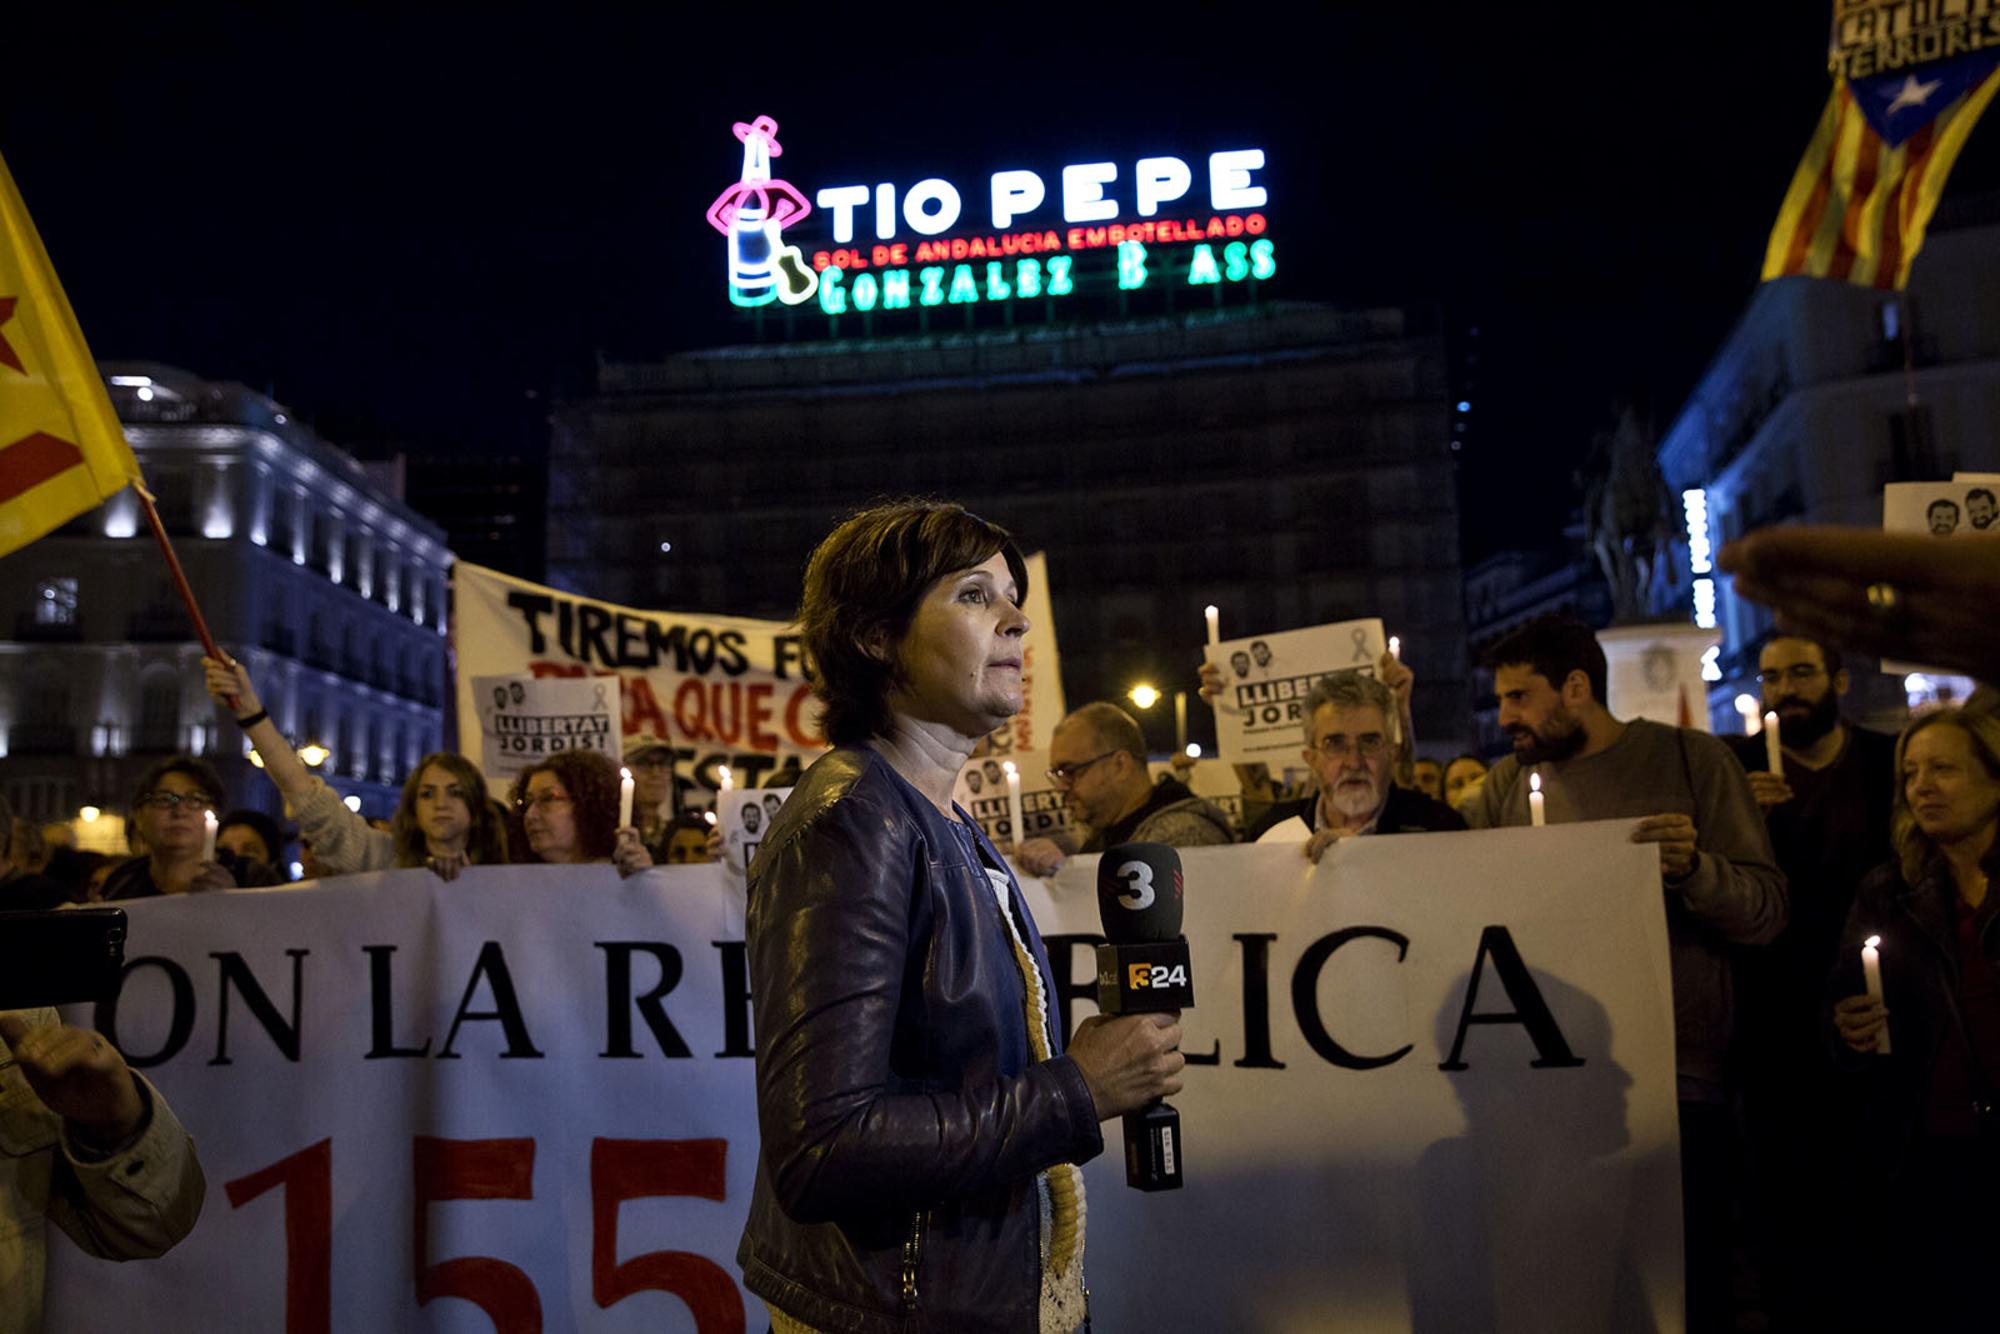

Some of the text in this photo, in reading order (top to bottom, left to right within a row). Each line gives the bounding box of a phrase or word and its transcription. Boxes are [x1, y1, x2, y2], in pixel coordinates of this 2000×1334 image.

[817, 148, 1268, 243] TIO PEPE
[813, 212, 1267, 273] SOL DE ANDALUCIA EMBOTELLADO
[818, 254, 1074, 315] GONZALEZ
[508, 591, 749, 677] TIREMOS
[496, 714, 609, 735] LLIBERTAT
[500, 735, 605, 752] JORDIS!
[1117, 860, 1155, 910] 3
[93, 948, 310, 1068] ON
[361, 941, 545, 1060] LA
[225, 1136, 748, 1334] 155
